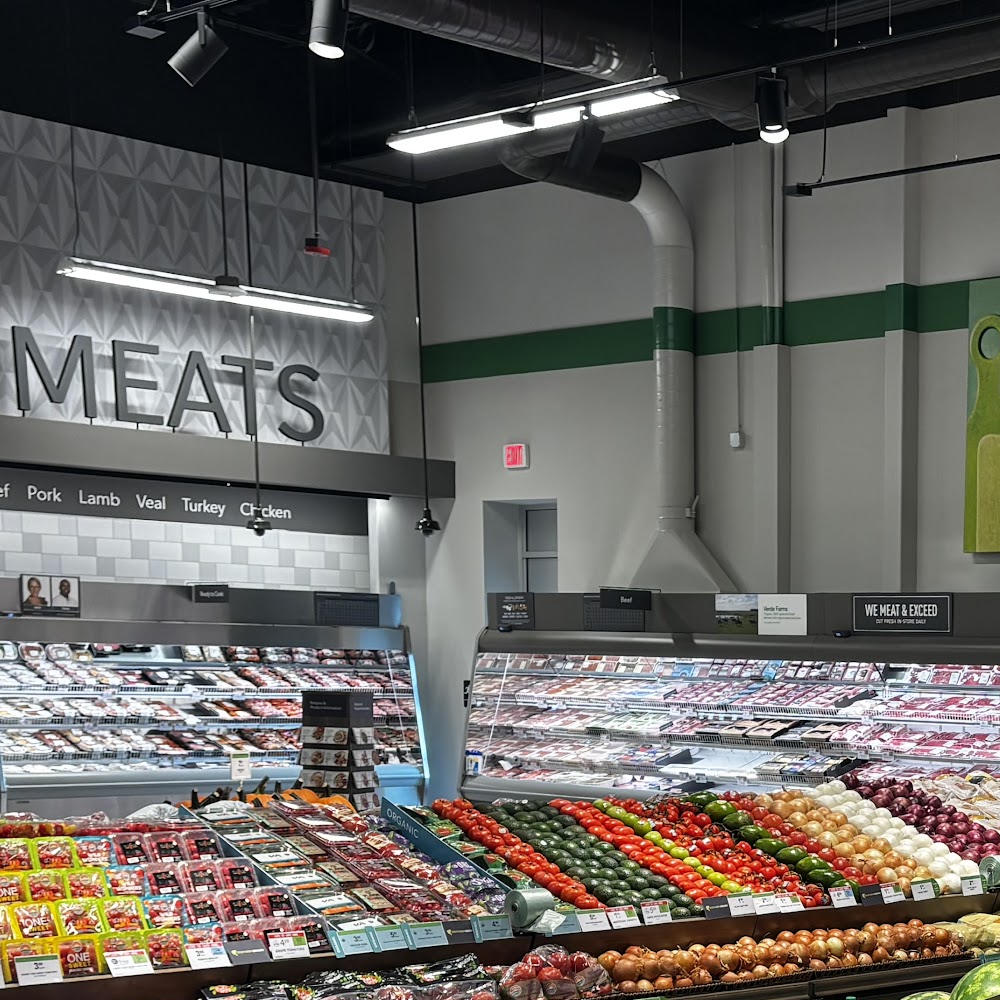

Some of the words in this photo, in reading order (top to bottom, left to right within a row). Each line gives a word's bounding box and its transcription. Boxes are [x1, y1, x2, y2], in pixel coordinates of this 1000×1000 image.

[11, 325, 325, 442] MEATS
[0, 484, 10, 499] ef
[27, 485, 62, 502] Pork
[78, 490, 121, 507] Lamb
[136, 494, 167, 510] Veal
[181, 498, 226, 517] Turkey
[239, 502, 292, 519] Chcken
[865, 603, 879, 617] WE
[879, 603, 900, 617] MEAT
[901, 604, 908, 617] &
[909, 604, 938, 617] EXCEED
[386, 808, 419, 839] ORGANIC
[66, 953, 90, 963] ONE
